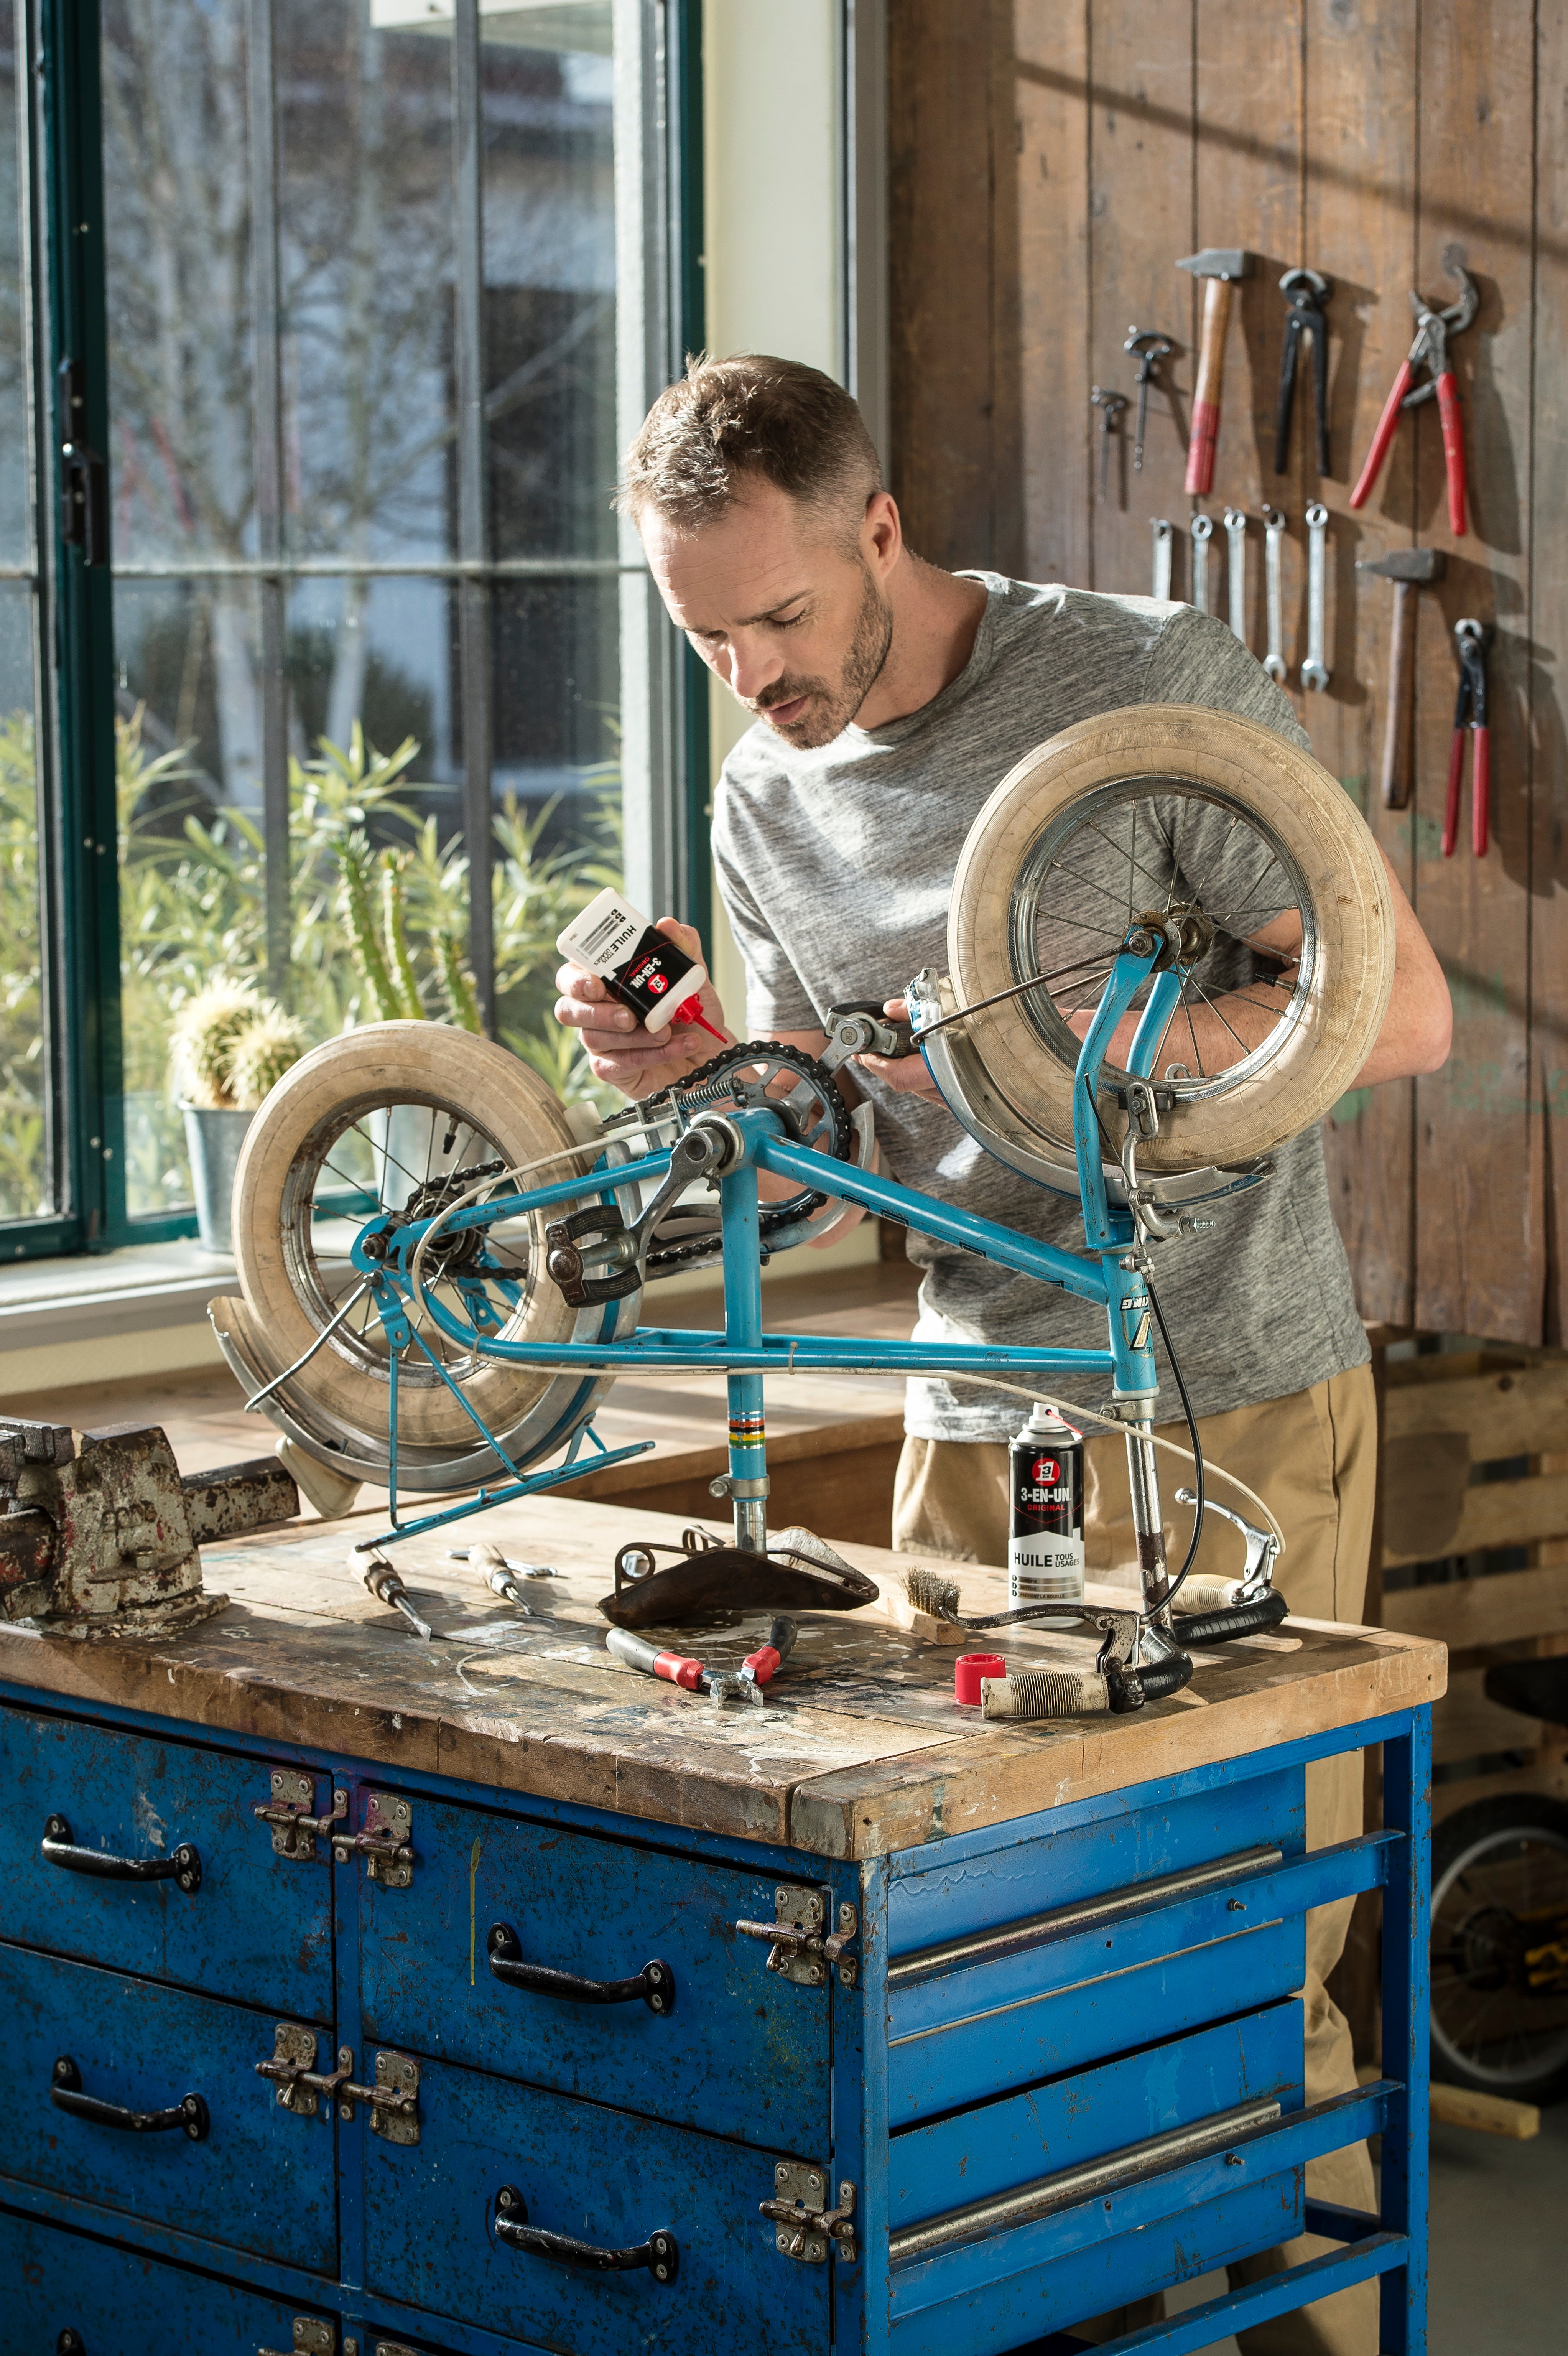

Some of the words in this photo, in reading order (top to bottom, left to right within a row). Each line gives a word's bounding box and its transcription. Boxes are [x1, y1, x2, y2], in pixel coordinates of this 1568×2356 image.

[610, 925, 637, 952] HUILE
[594, 948, 610, 966] USAGES
[602, 952, 614, 963] TOUS
[629, 957, 650, 977] ORIGINAL
[1015, 1552, 1053, 1567] HUILE
[1055, 1558, 1079, 1567] USAGES
